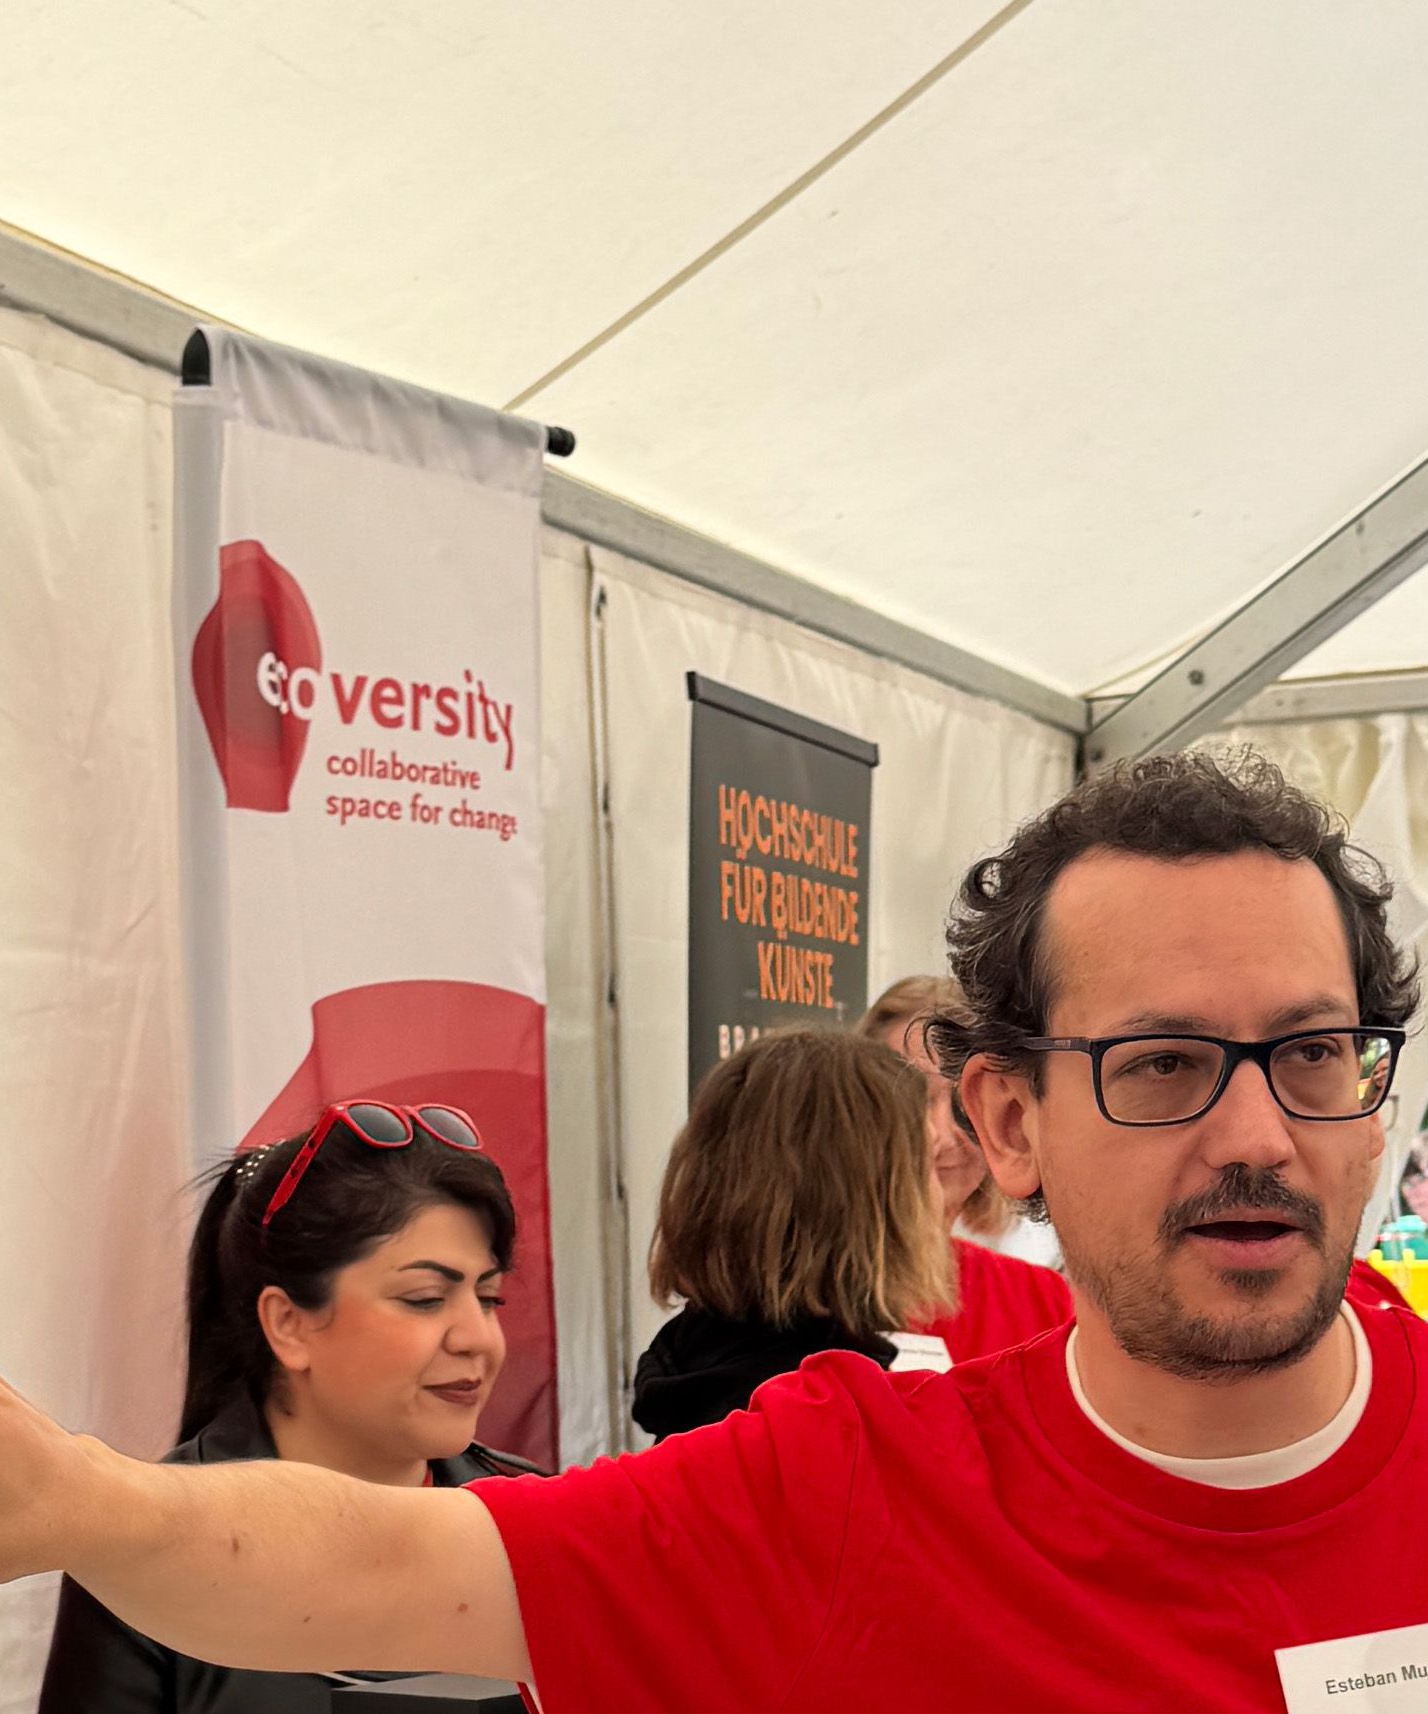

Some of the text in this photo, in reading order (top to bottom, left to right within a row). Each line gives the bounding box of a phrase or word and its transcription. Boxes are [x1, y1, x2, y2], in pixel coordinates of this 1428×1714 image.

[326, 748, 482, 791] collaborative
[325, 794, 403, 827] space
[410, 792, 443, 825] for
[717, 783, 859, 879] HOCHSCHULE
[770, 870, 860, 946] BILDENDE
[1325, 1670, 1397, 1695] Esteban
